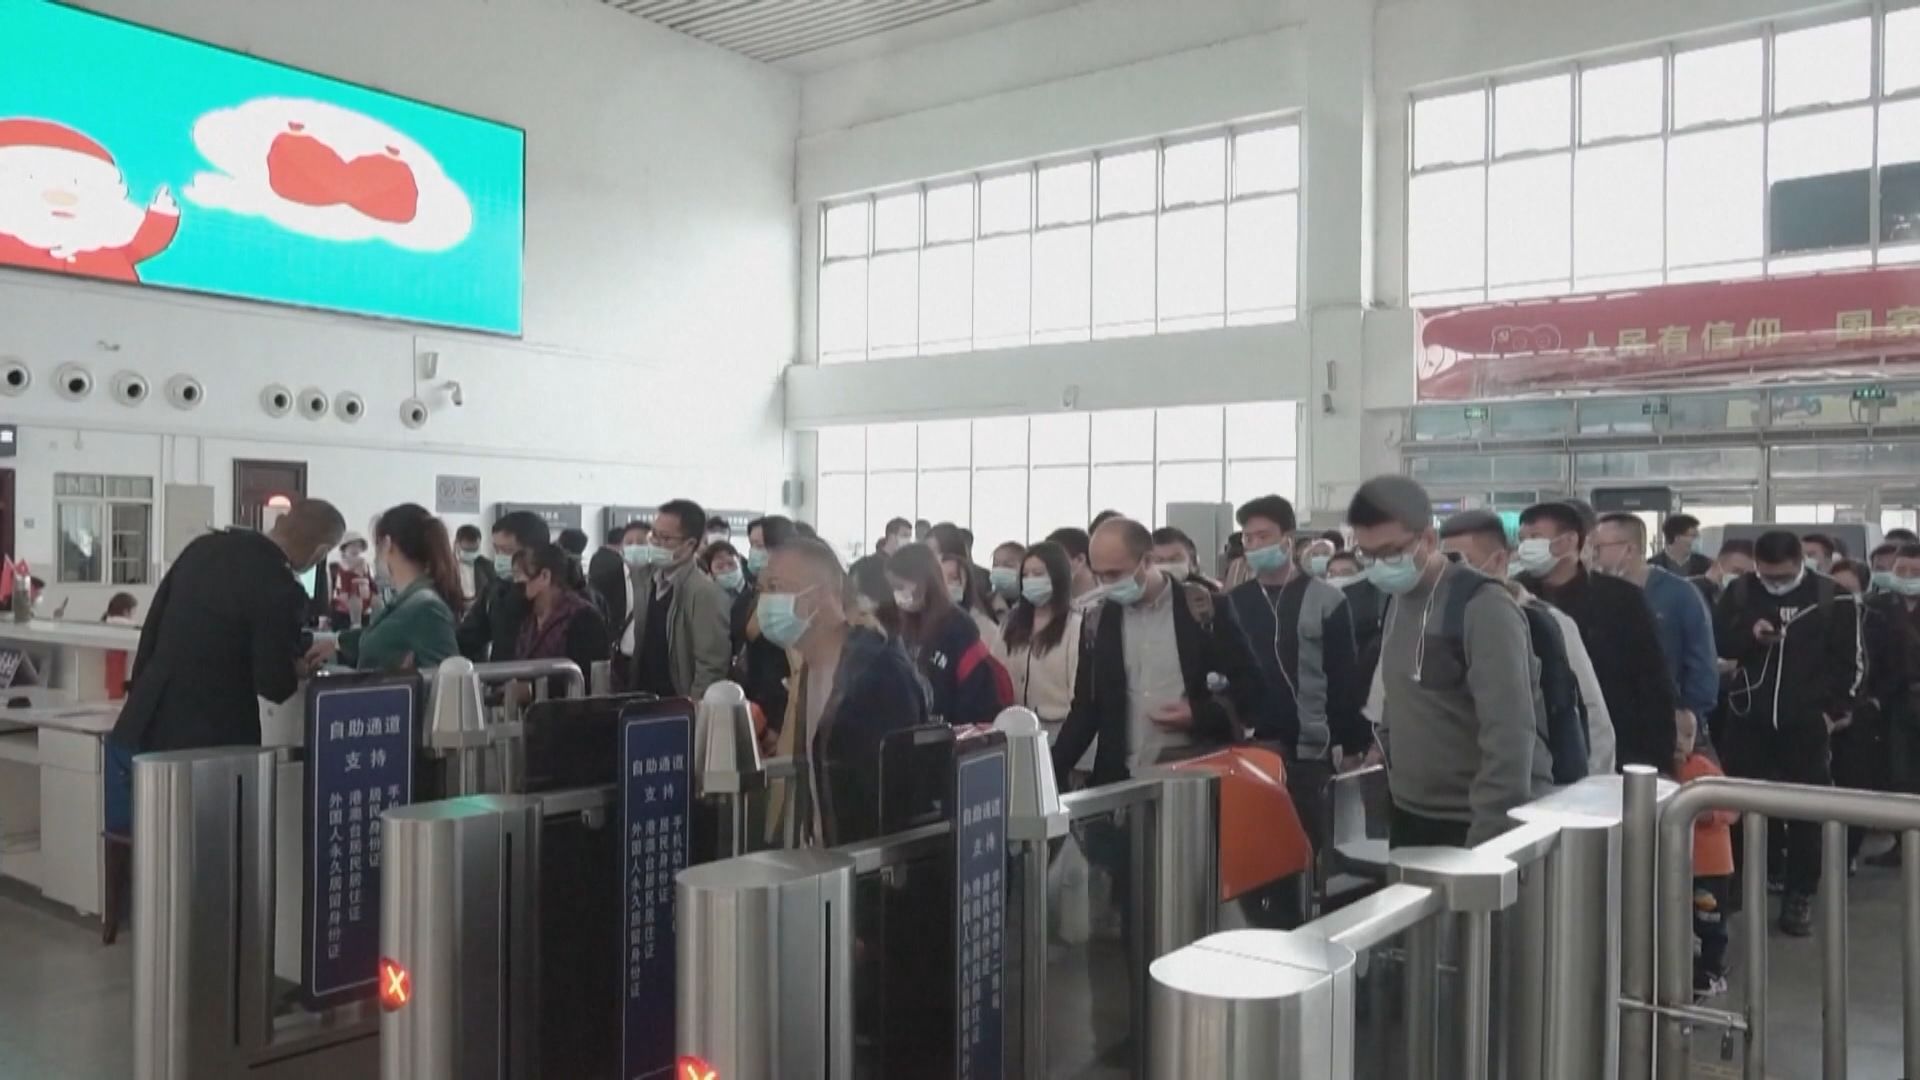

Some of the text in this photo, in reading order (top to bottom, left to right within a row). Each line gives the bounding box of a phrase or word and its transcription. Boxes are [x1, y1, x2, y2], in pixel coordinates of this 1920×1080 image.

[330, 714, 401, 741] 自助通道
[344, 748, 387, 773] 支持
[632, 753, 684, 777] 自助通道
[644, 783, 675, 803] 支持
